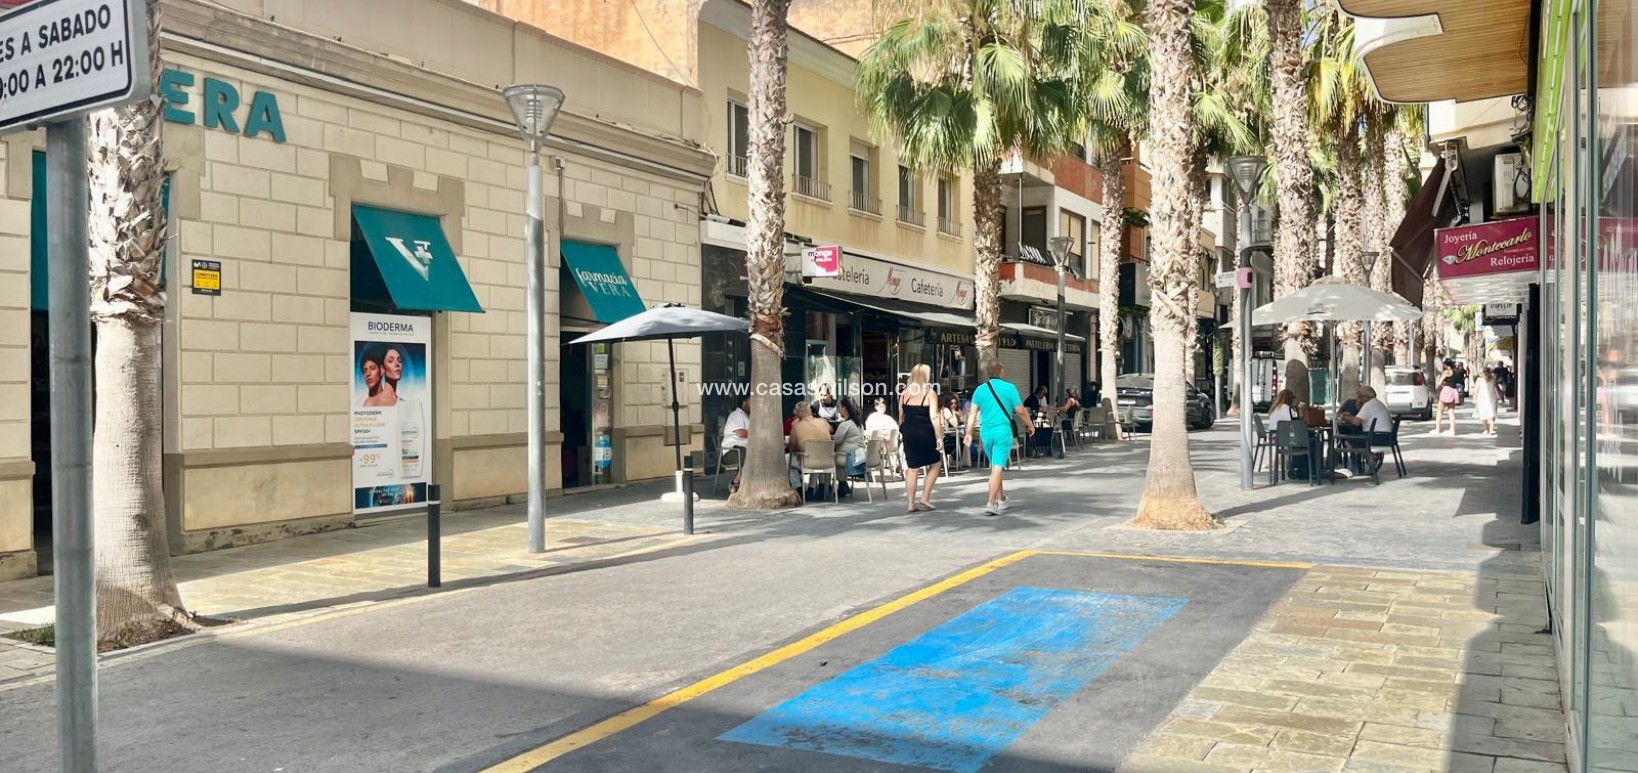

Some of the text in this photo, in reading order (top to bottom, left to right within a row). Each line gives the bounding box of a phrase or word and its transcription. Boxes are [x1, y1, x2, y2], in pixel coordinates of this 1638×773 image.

[21, 31, 31, 56] A
[38, 4, 111, 49] SABADO
[35, 64, 46, 89] A
[52, 46, 105, 84] 22:00
[110, 40, 123, 67] H
[1444, 230, 1477, 244] Joyería
[1455, 227, 1531, 264] Montecarlo
[1490, 253, 1535, 267] Relojería
[589, 282, 632, 297] VERA
[368, 321, 414, 333] BIODERMA
